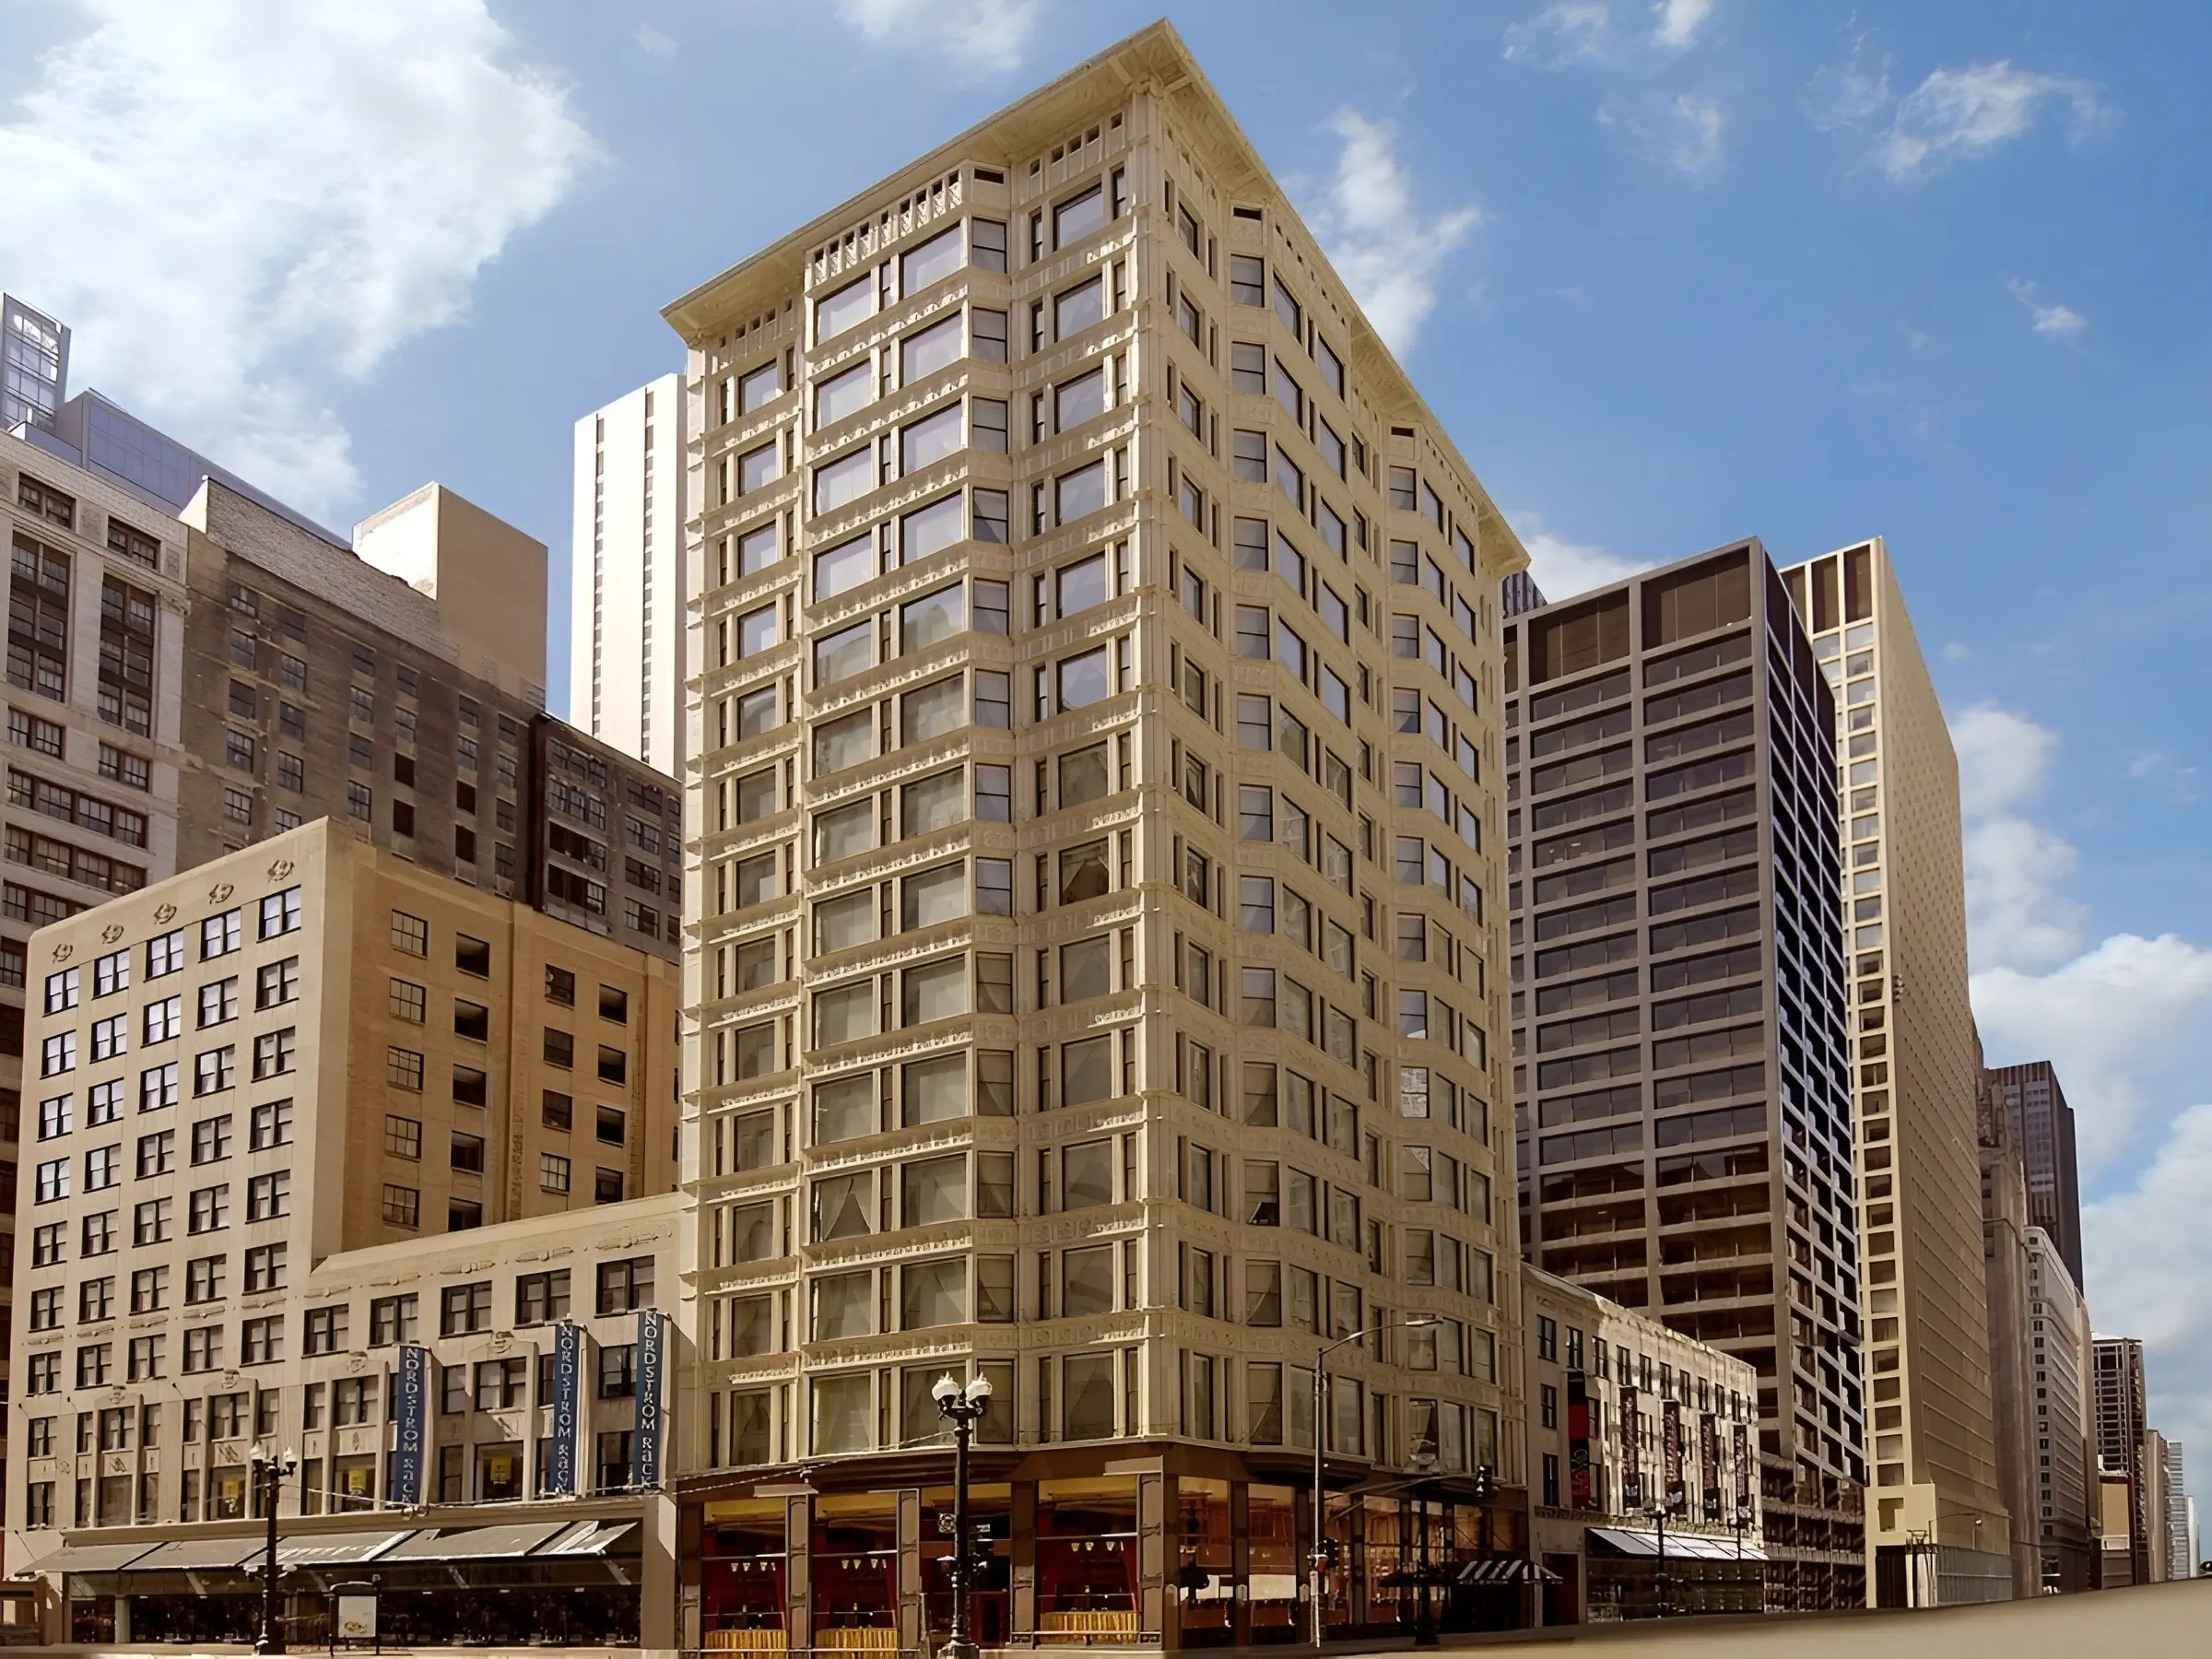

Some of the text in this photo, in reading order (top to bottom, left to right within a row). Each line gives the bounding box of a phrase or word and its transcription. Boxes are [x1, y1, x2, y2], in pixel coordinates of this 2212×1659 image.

[403, 1347, 419, 1452] NORDSTROM
[559, 1325, 573, 1438] NORDSTROM
[641, 1311, 658, 1430] NORDSTROM
